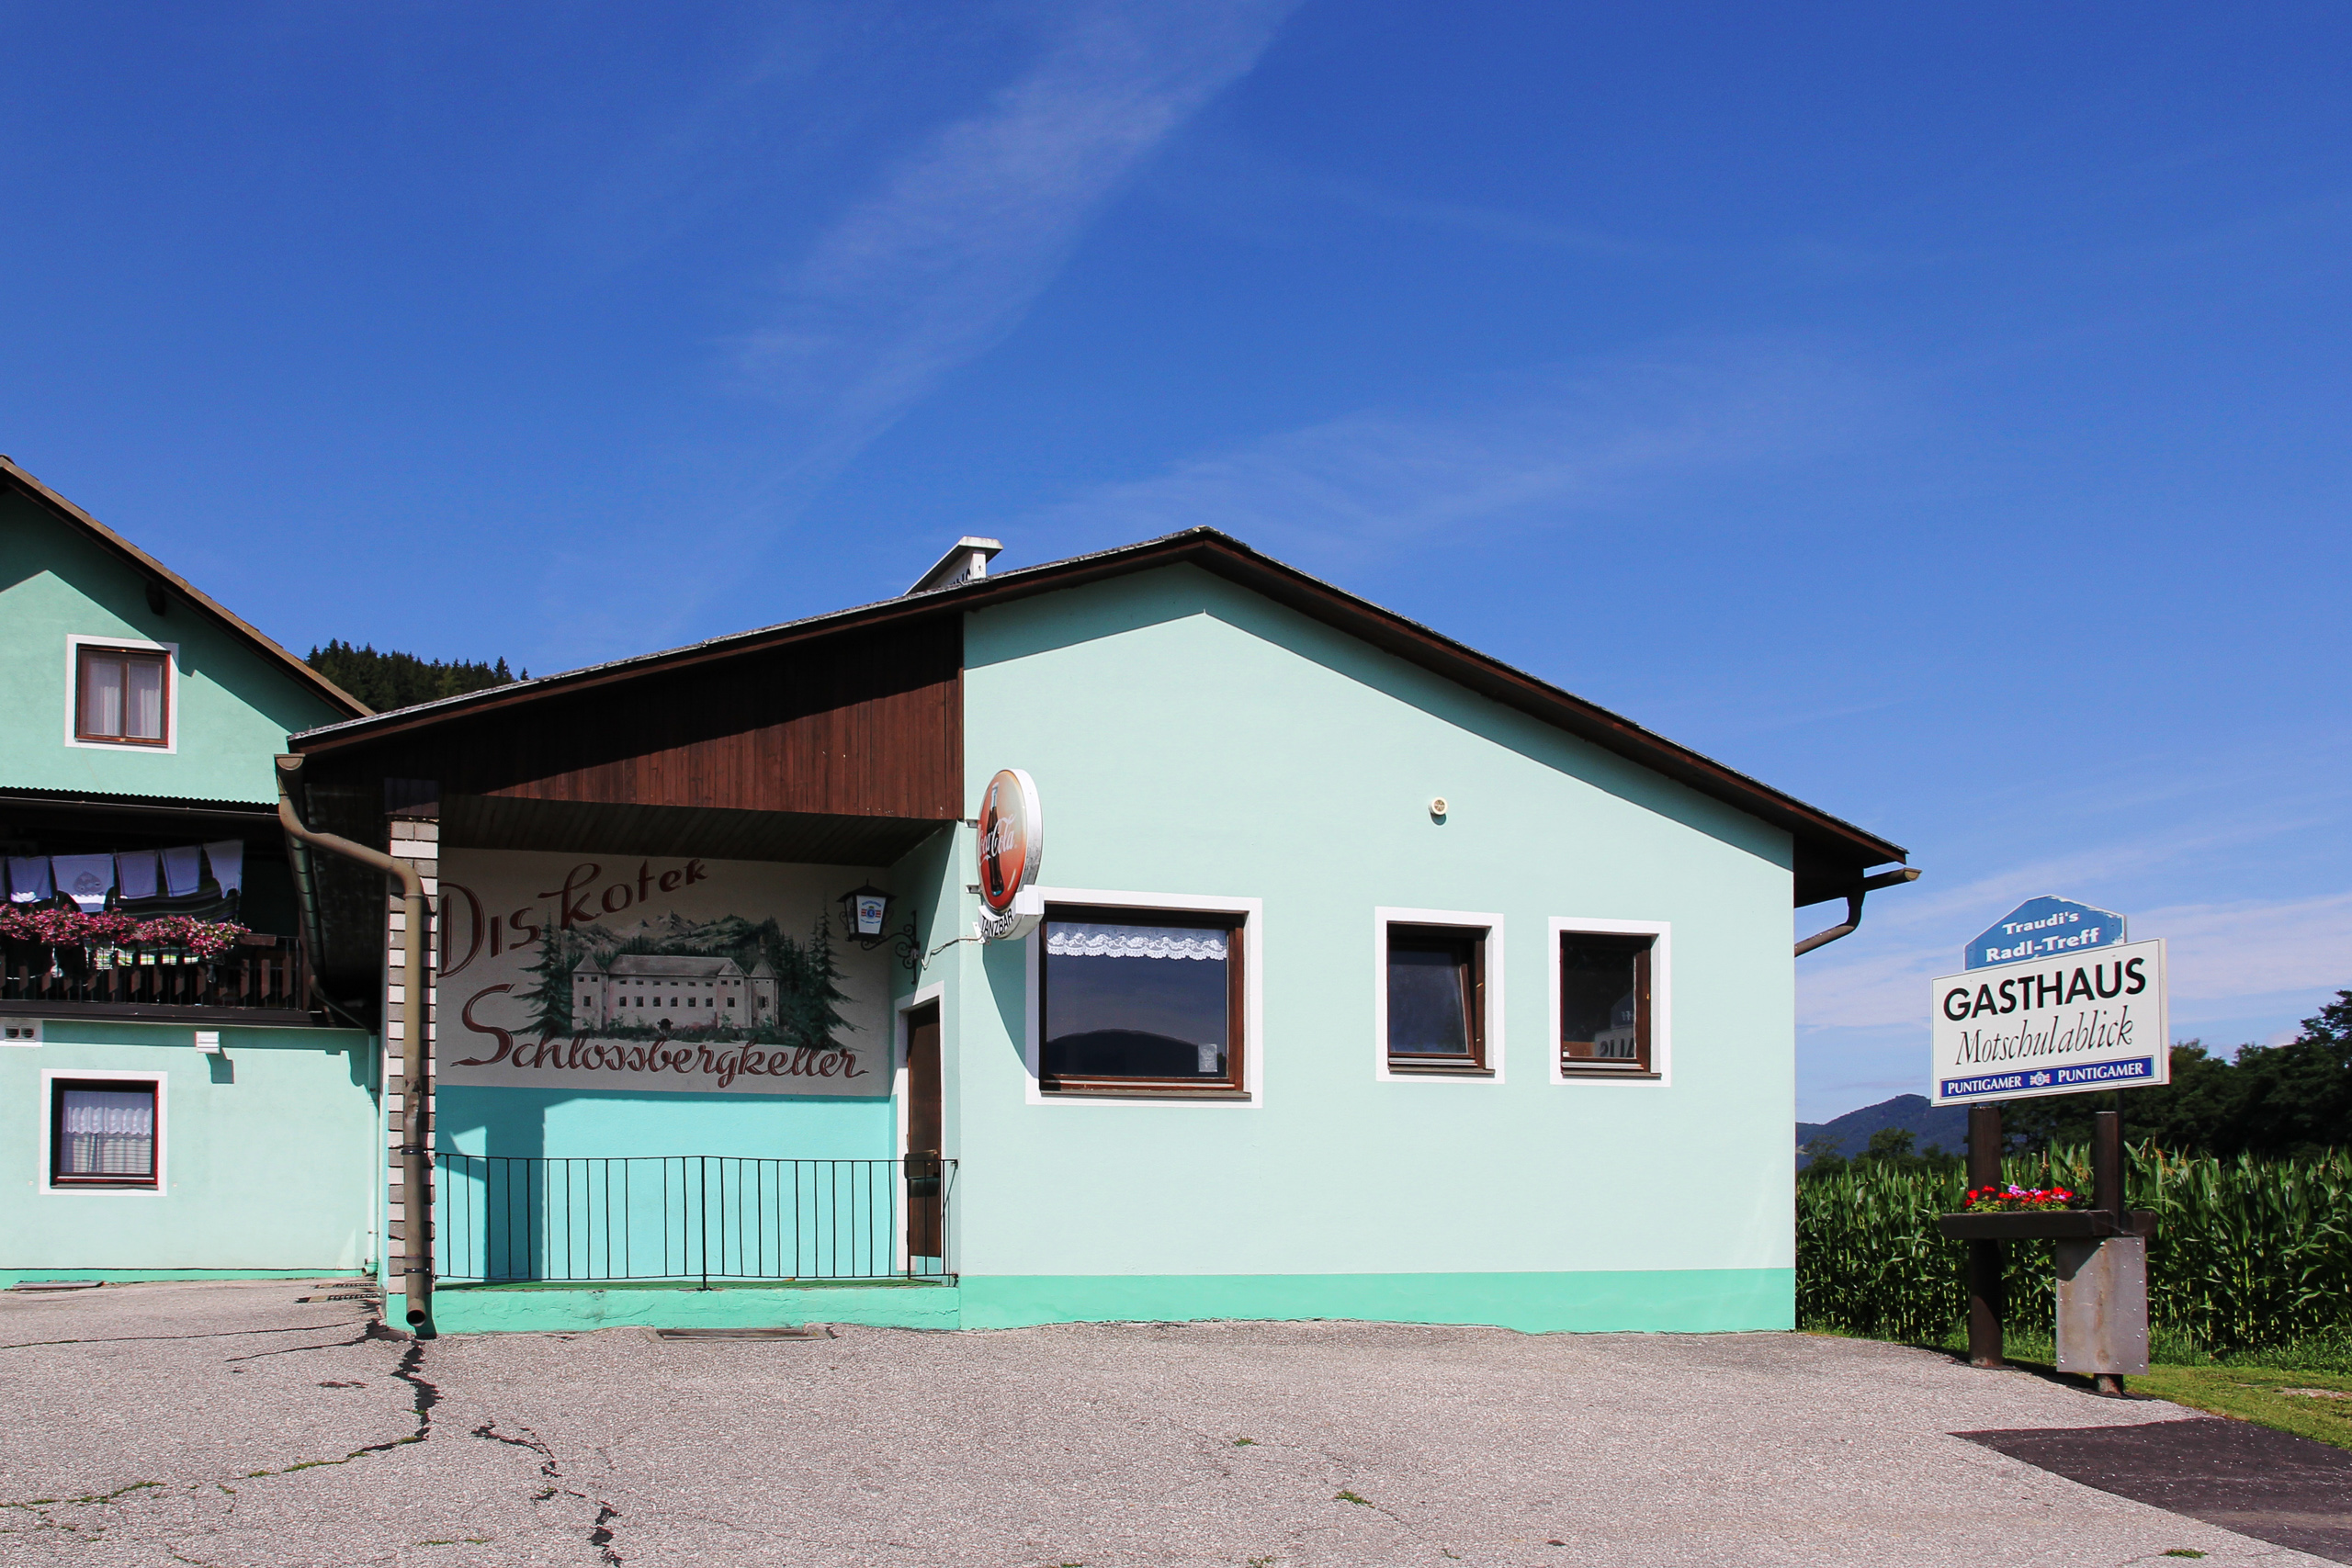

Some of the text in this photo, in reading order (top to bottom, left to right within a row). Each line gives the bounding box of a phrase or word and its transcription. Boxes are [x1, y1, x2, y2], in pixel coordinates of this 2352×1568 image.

[980, 908, 1013, 937] TANZBAR
[2002, 911, 2079, 935] Traudi's
[1985, 927, 2100, 963] Radl-Treff
[1943, 957, 2146, 1021] GASTHAUS
[450, 983, 869, 1089] Schlossbergkeller
[1955, 1004, 2133, 1066] Motschulablick
[1948, 1062, 2143, 1094] PUNTIGAMER PUNTIGAMER
